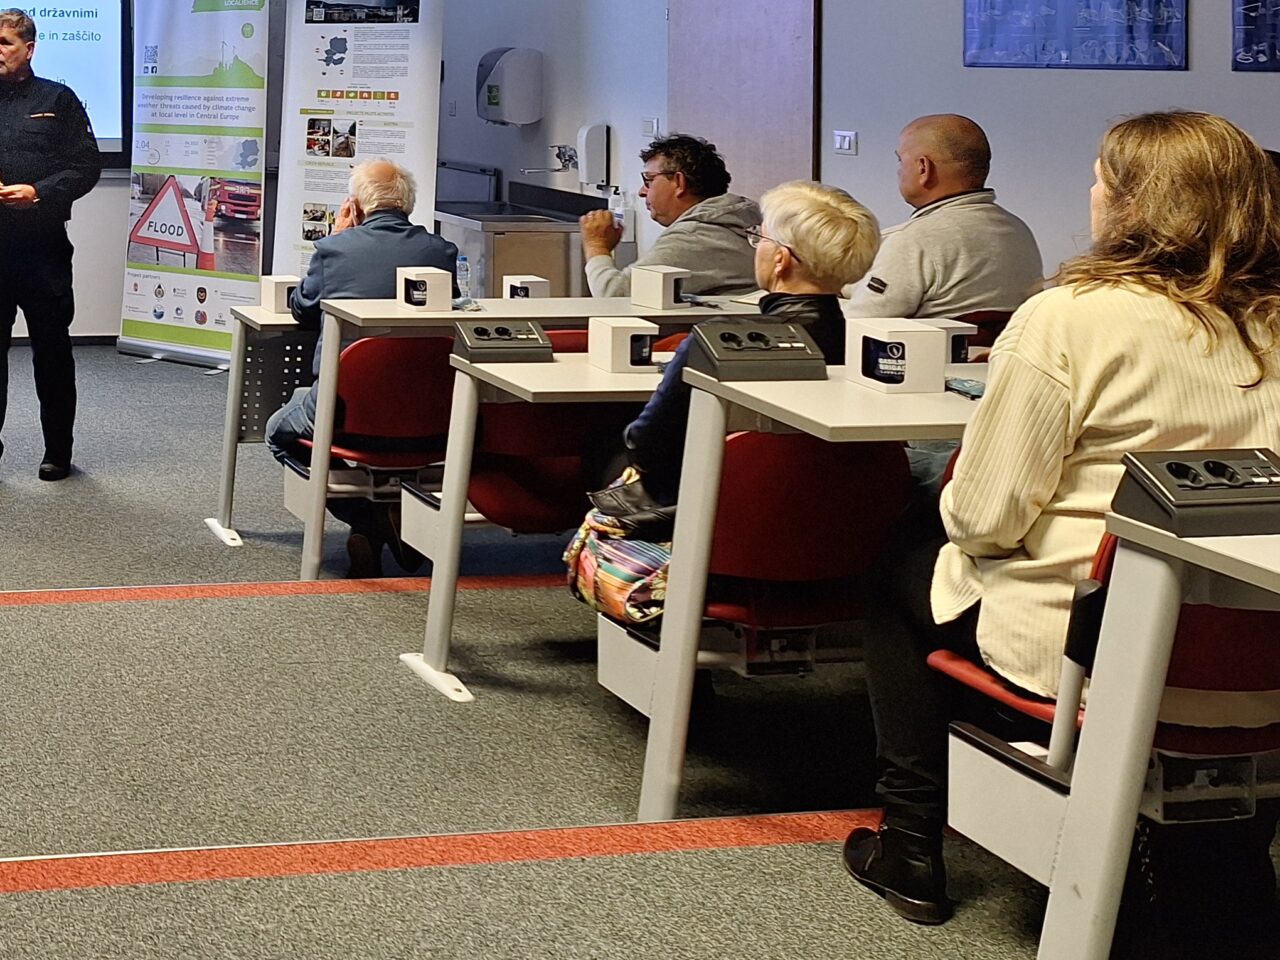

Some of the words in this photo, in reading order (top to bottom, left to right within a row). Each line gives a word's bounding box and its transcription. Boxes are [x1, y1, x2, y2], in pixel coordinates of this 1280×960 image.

[39, 7, 98, 19] državnimi
[49, 30, 58, 40] in
[62, 30, 101, 41] zaščito
[142, 93, 173, 102] Developing
[203, 95, 224, 103] against
[147, 221, 184, 237] FLOOD
